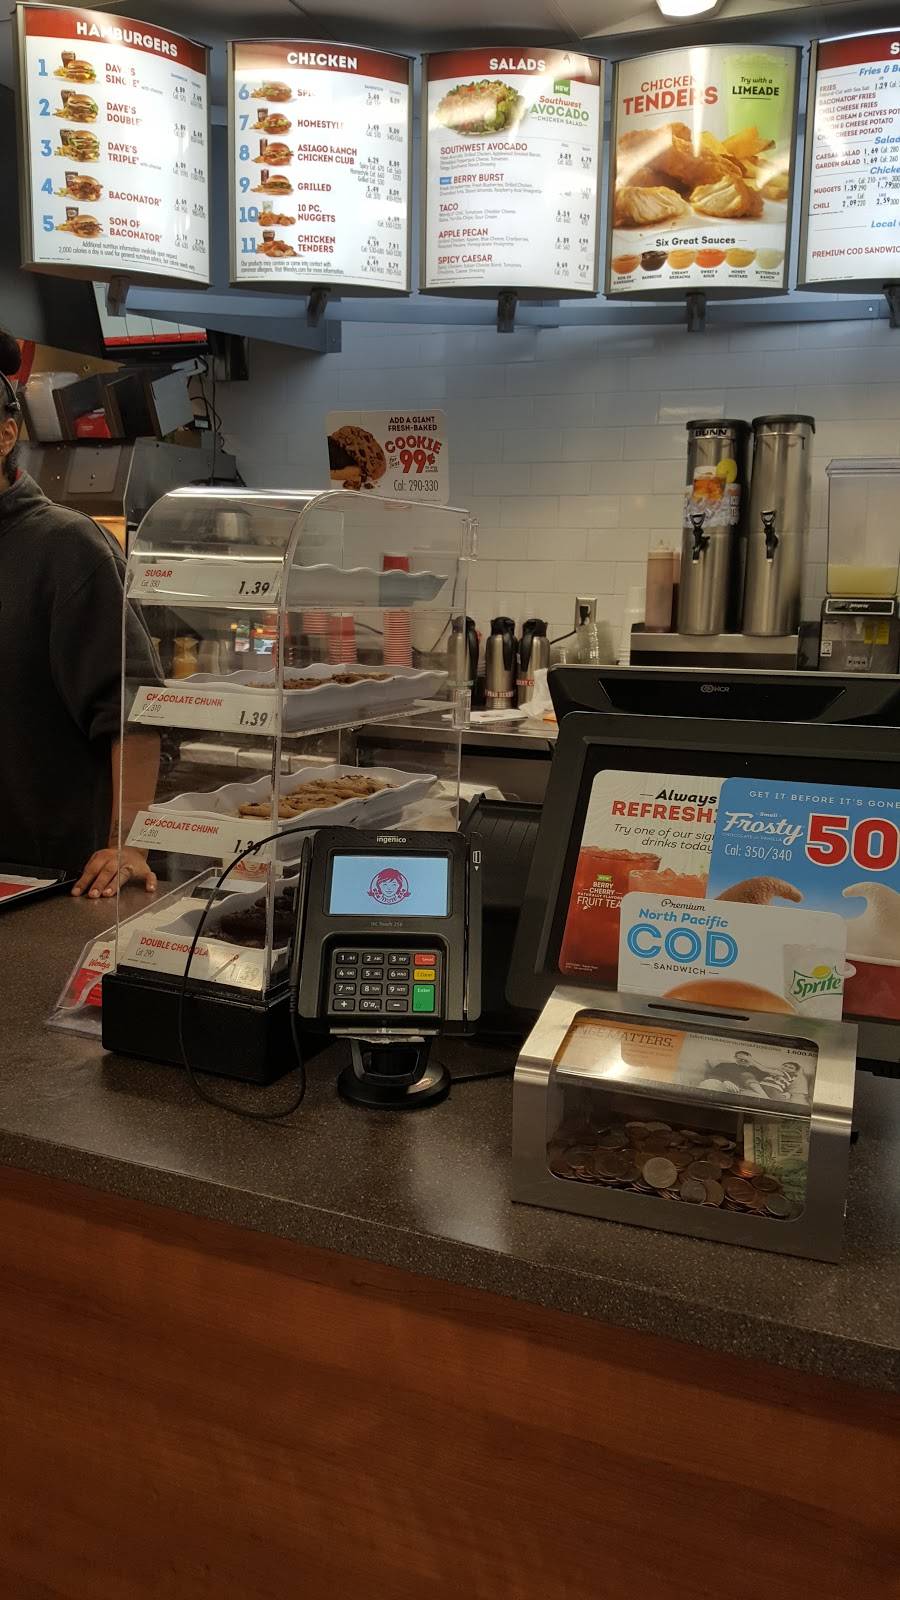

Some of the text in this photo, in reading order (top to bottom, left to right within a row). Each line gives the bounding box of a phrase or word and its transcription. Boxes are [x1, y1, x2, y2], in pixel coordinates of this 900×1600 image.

[77, 21, 178, 57] HAMBURGERS
[38, 59, 48, 76] 1
[287, 52, 358, 70] CHICKEN
[489, 57, 546, 72] SALADS
[858, 66, 882, 77] Fries
[740, 76, 752, 84] Try
[752, 76, 768, 84] with
[238, 84, 250, 100] 6
[732, 86, 780, 96] LIMEADE
[820, 84, 837, 92] FRIES
[540, 95, 582, 109] Southwest
[858, 92, 876, 100] FRIES
[39, 98, 50, 116] 2
[106, 102, 137, 114] DAVE'S
[529, 104, 590, 122] AVOCADO
[836, 101, 878, 112] CHEESE FRIES
[864, 110, 887, 118] CHIVES
[239, 115, 250, 131] 7
[538, 116, 582, 127] CHICKEN SALAD
[846, 120, 868, 128] CHEESE
[870, 118, 894, 126] POTATO
[41, 139, 52, 157] 3
[107, 142, 137, 154] DAVE'S
[239, 145, 250, 161] 8
[298, 144, 328, 153] ASIAGO
[440, 142, 528, 155] SOUTHWEST AVOCADO
[108, 153, 137, 164] TRIPLE
[298, 154, 354, 165] CHICKEN CLUB
[816, 152, 837, 160] CAESA
[816, 158, 861, 170] GARDEN SALAD
[239, 177, 332, 193] 9 GRILLED
[454, 173, 504, 184] BERRY BURST
[41, 177, 53, 195] 4
[814, 186, 842, 195] NUGGETS
[108, 191, 160, 206] BACONATOR
[440, 203, 458, 212] TACO
[813, 202, 830, 210] CHILI
[239, 204, 322, 222] 10 10 PC.
[298, 213, 336, 223] NUGGETS
[43, 215, 54, 232] 5
[109, 217, 128, 226] SON
[870, 218, 896, 228] Local
[109, 228, 160, 242] BACONATOR
[438, 228, 488, 239] APPLE PECAN
[241, 235, 336, 254] 11 CHICKEN
[656, 236, 736, 248] Six Great Sauces
[298, 244, 334, 254] TENDERS
[812, 248, 845, 259] PREMIUM
[846, 248, 864, 256] COD
[438, 254, 493, 265] SPICY CAESAR
[389, 416, 435, 424] ADD A GIANT
[388, 424, 438, 432] FRESH-BAKED
[696, 429, 727, 437] BUNN
[384, 434, 442, 454] COOKIE
[400, 450, 436, 474] 99¢
[394, 480, 439, 492] Cal: 290-330
[144, 569, 173, 578] SUGAR
[238, 580, 270, 596] 1.39
[146, 693, 223, 706] CHOCOLATE CHUNK
[238, 710, 268, 728] 1.39
[654, 788, 718, 807] Always
[750, 790, 770, 799] GET
[775, 792, 787, 800] IT
[791, 794, 835, 804] BEFORE
[840, 797, 863, 807] IT'S
[611, 800, 718, 824] REFRESH
[144, 818, 220, 834] CHOCOLATE CHUNK
[614, 824, 632, 836] Try
[634, 827, 656, 836] one
[658, 828, 672, 840] of
[672, 831, 693, 840] our
[724, 811, 804, 846] Frosty
[376, 836, 407, 844] ingenico
[641, 837, 713, 854] drinks today
[724, 844, 793, 862] Cal: 350/340
[589, 888, 616, 896] CHERRY
[576, 896, 622, 909] FRUIT TEA
[661, 898, 706, 912] Premium
[638, 907, 729, 930] North Pacific
[140, 936, 209, 958] DOUBLE CHOCOLA
[627, 922, 738, 968] COD
[654, 962, 706, 976] SANDWICH
[793, 974, 842, 998] Sprite
